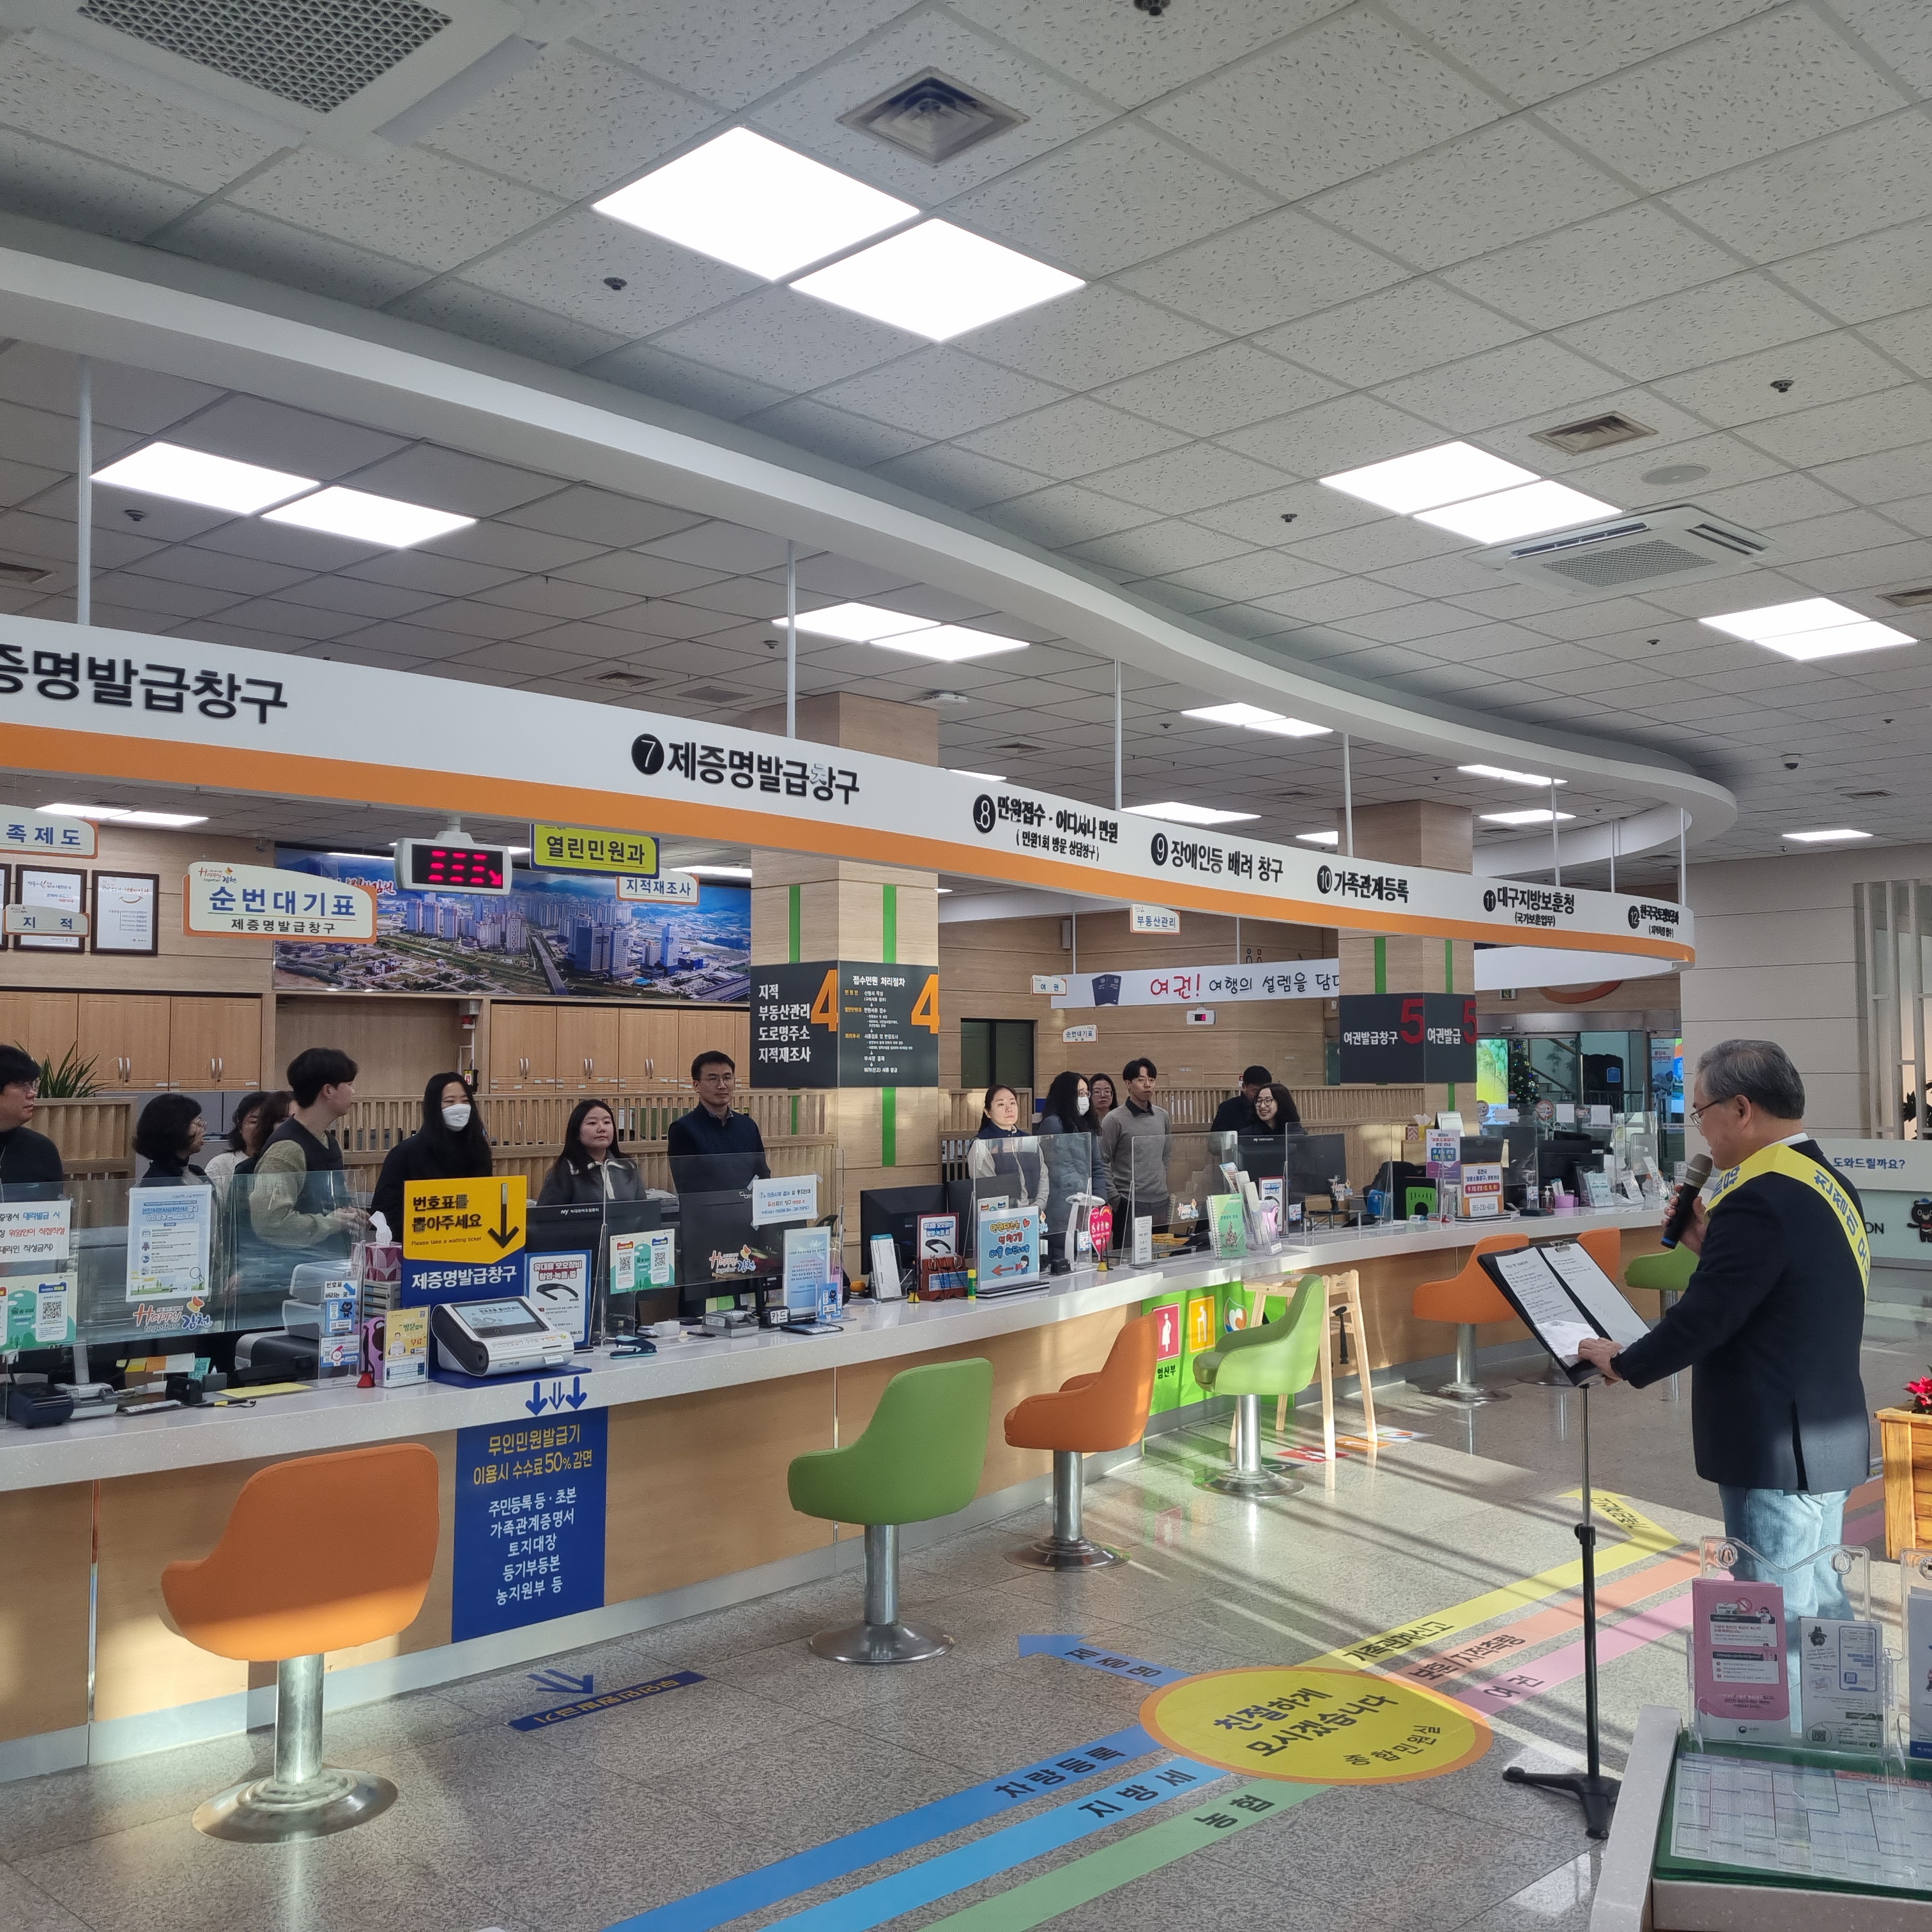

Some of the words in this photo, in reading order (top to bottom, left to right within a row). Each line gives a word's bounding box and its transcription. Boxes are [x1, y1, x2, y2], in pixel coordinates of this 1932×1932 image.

[0, 642, 288, 724] 증명발급창구
[668, 741, 860, 804] 제증명발급창구
[997, 795, 1046, 827] 민원접수
[1056, 809, 1096, 839] 어디서나
[1099, 820, 1118, 844] 민원
[546, 836, 645, 865] 열린민원과
[1052, 836, 1067, 854] 방문
[1170, 840, 1223, 874] 장애인등
[1228, 850, 1253, 879] 배려
[1258, 856, 1283, 883] 창구
[222, 875, 238, 884] 김천
[626, 878, 691, 896] 지적재조사
[1334, 871, 1409, 903] 가족관계등록
[209, 886, 356, 917] 순번대기표
[1497, 887, 1575, 914] 대구지방보훈청
[23, 916, 73, 930] 지적
[231, 917, 335, 934] 제증명발급창구
[1137, 915, 1176, 928] 부동산관리
[1515, 911, 1556, 927] (국가보훈업무)
[1040, 982, 1059, 992] 여권
[1151, 973, 1201, 1000] 여권!
[1209, 976, 1252, 995] 여행의
[1262, 972, 1307, 993] 설렘을
[758, 983, 779, 1000] 지적
[810, 969, 838, 1032] 4
[758, 1003, 810, 1021] 부동산관리
[853, 976, 878, 986] 접수민원
[880, 977, 905, 987] 처리절차
[911, 974, 940, 1034] 4
[758, 1025, 810, 1041] 도로명주소
[1066, 1030, 1093, 1038] 순번대기표
[1344, 1031, 1399, 1045] 여권발급창구
[1400, 998, 1425, 1044] 5
[1427, 1027, 1461, 1044] 여권발급
[1462, 1000, 1478, 1044] 5
[758, 1046, 811, 1062] 지적재조사
[1834, 1156, 1905, 1170] 도와드릴까요?
[413, 1194, 469, 1212] 번호표를
[38, 1227, 65, 1236] 직접작성
[411, 1213, 482, 1232] 뽑아주세요
[448, 1236, 466, 1245] waiting
[411, 1266, 517, 1290] 제증명발급창구
[534, 1262, 555, 1271] 휴대용
[555, 1260, 583, 1269] 보호장비
[133, 1303, 183, 1328] Happy
[144, 1322, 179, 1333] together
[181, 1312, 213, 1330] 김천
[770, 1310, 788, 1323] 카드
[1157, 1364, 1176, 1380] 임산부
[488, 1424, 581, 1457] 무인민원발급기
[473, 1462, 509, 1485] 이용시
[488, 1494, 533, 1519] 주민등록
[490, 1507, 575, 1538] 가족관계증명서
[508, 1533, 557, 1558] 토지대장
[502, 1554, 561, 1582] 등기부등본
[495, 1579, 546, 1606] 농지원부
[551, 1576, 563, 1593] 등
[1342, 1621, 1455, 1661] 가족관계신고
[1483, 1675, 1545, 1699] 여권
[533, 1678, 680, 1723] 무인민원발급기
[1213, 1687, 1333, 1731] 친절하게
[1246, 1694, 1399, 1757] 모시겠습니다
[1343, 1725, 1441, 1766] 종합민원실
[994, 1746, 1127, 1798] 차량등록
[1078, 1769, 1198, 1818] 지방세
[1193, 1794, 1276, 1828] 농협
